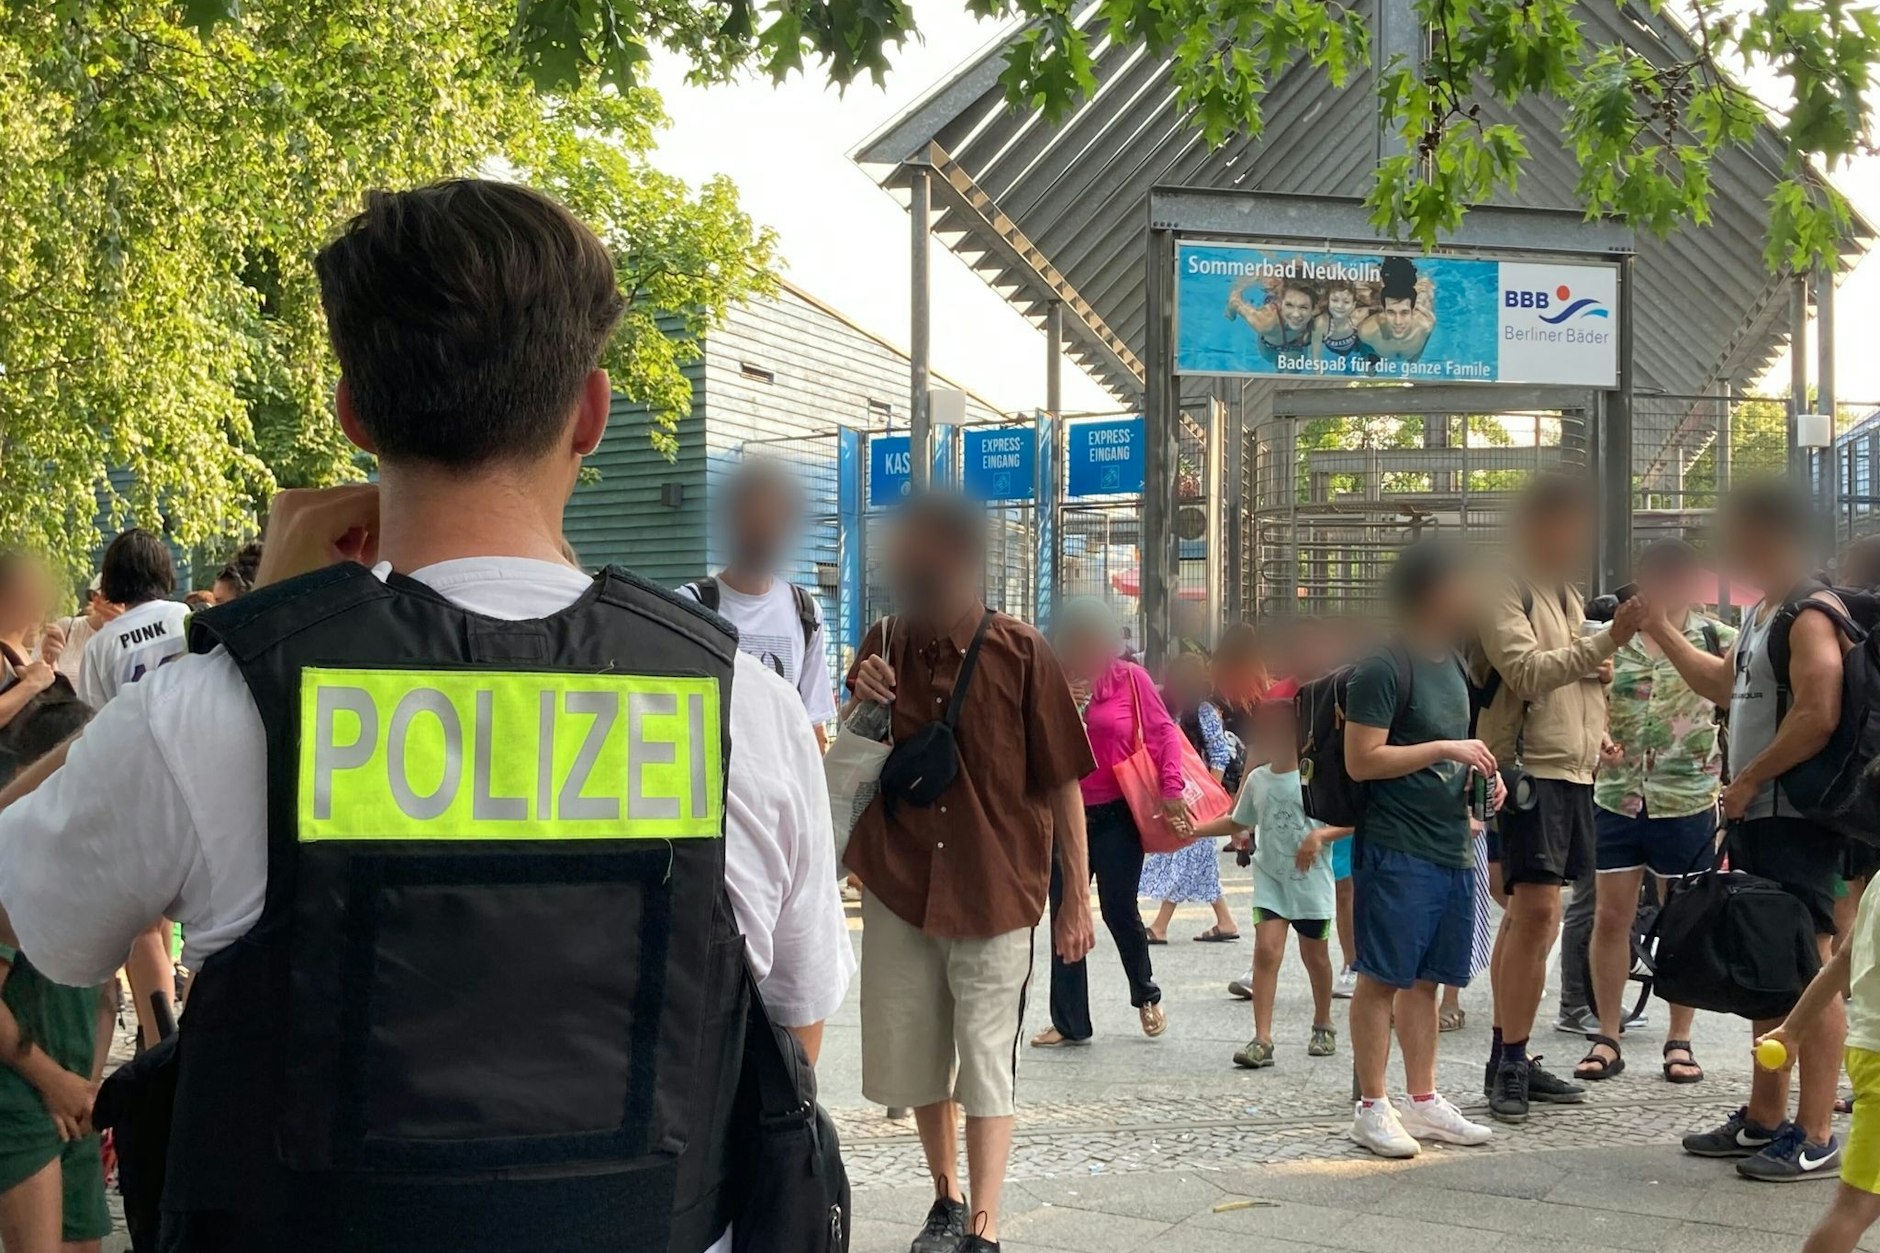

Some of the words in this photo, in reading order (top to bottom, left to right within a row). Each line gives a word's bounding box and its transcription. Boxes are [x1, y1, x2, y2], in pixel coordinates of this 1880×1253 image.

[1188, 255, 1296, 279] Sommerbad
[1302, 260, 1381, 282] Neukölln
[1505, 290, 1549, 309] BBB
[1505, 325, 1563, 342] Berliner
[1566, 328, 1608, 344] Bäder
[1277, 354, 1346, 375] Badespaß
[1350, 356, 1372, 373] für
[1375, 358, 1396, 374] die
[1401, 361, 1442, 377] ganze
[982, 437, 1024, 453] EXPRESS-
[1088, 428, 1135, 446] EXPRESS-
[885, 452, 911, 475] KAS
[982, 454, 1020, 469] EINGANG
[1090, 445, 1130, 463] EINGANG
[119, 621, 167, 649] PUNK
[313, 685, 708, 821] POLIZEI
